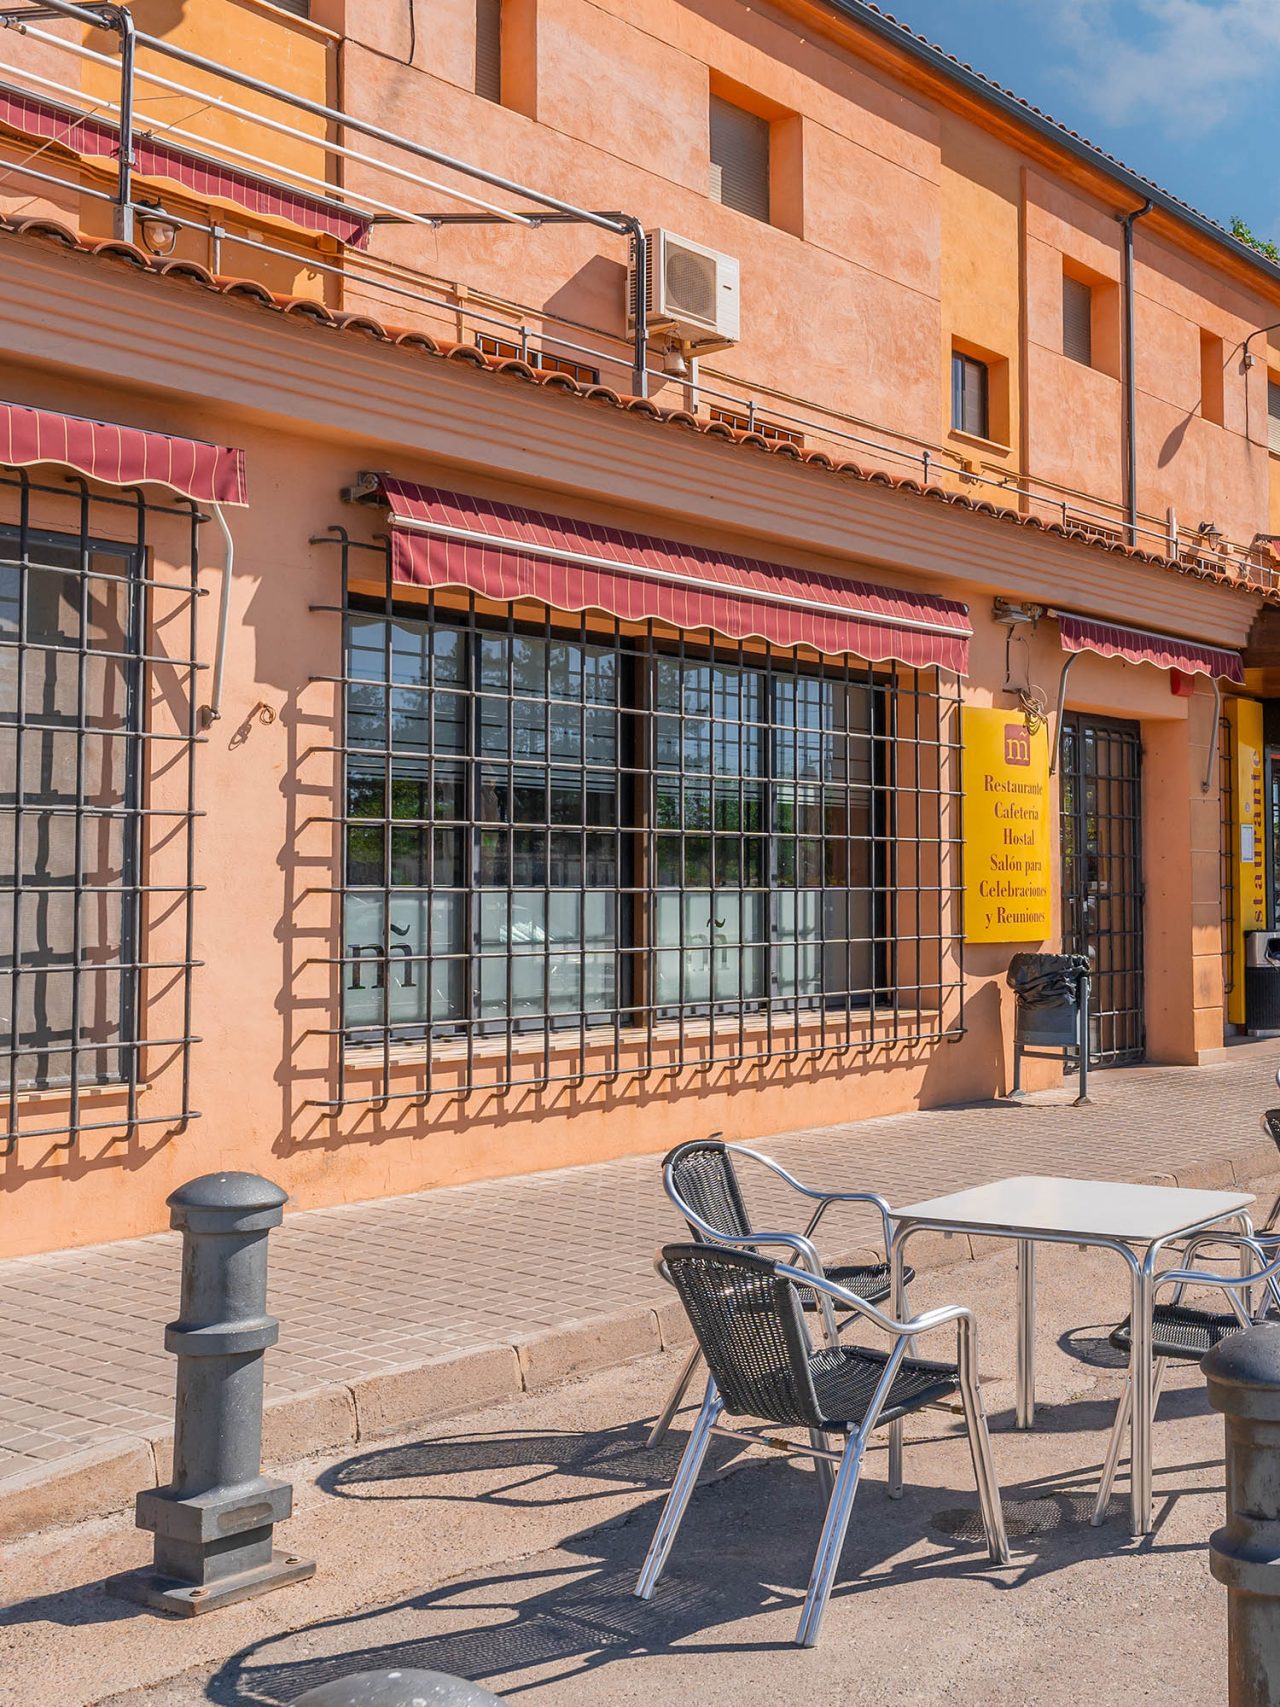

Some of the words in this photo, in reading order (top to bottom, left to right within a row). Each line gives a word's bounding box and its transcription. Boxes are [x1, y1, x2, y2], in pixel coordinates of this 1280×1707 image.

[984, 774, 1043, 796] Restaurante
[1003, 828, 1035, 845] Hostal
[990, 853, 1022, 871] Salón
[1025, 861, 1042, 876] para
[979, 880, 1047, 897] Celebraciones
[985, 913, 992, 929] y
[997, 906, 1045, 924] Reuniones
